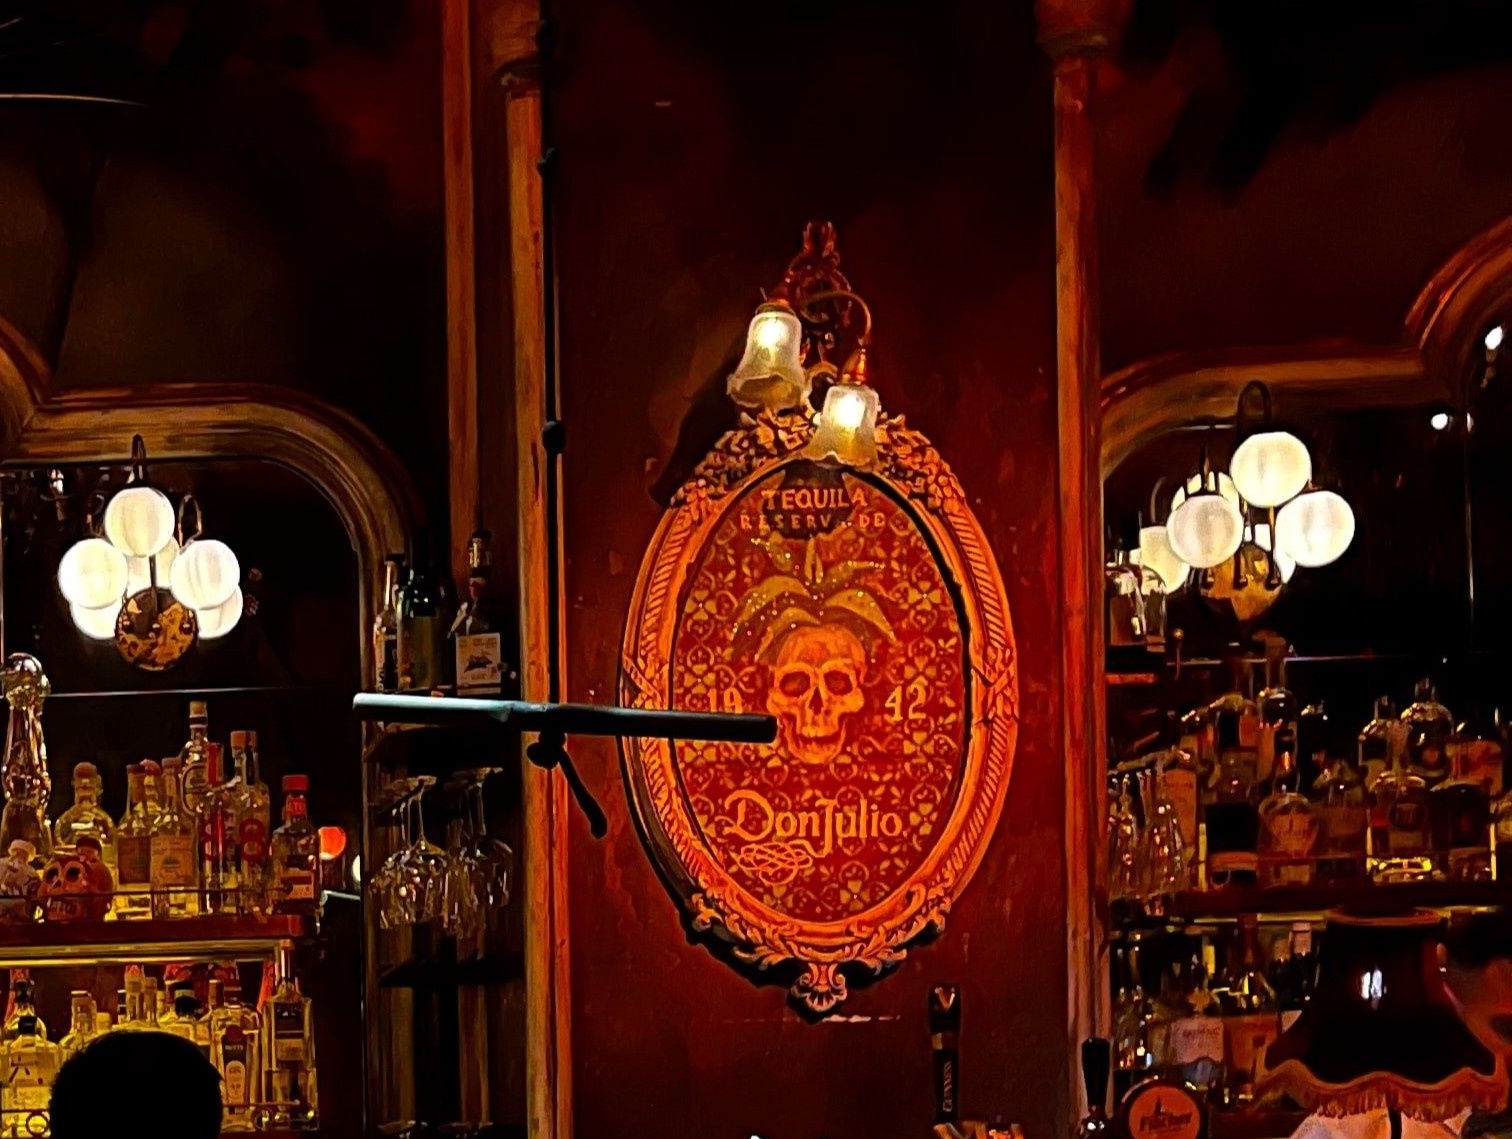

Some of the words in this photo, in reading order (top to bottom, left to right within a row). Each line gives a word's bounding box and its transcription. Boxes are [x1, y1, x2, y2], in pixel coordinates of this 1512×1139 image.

[761, 488, 868, 510] TEQUILA
[740, 513, 850, 531] RESERV
[708, 687, 743, 714] 19
[885, 681, 927, 722] 42
